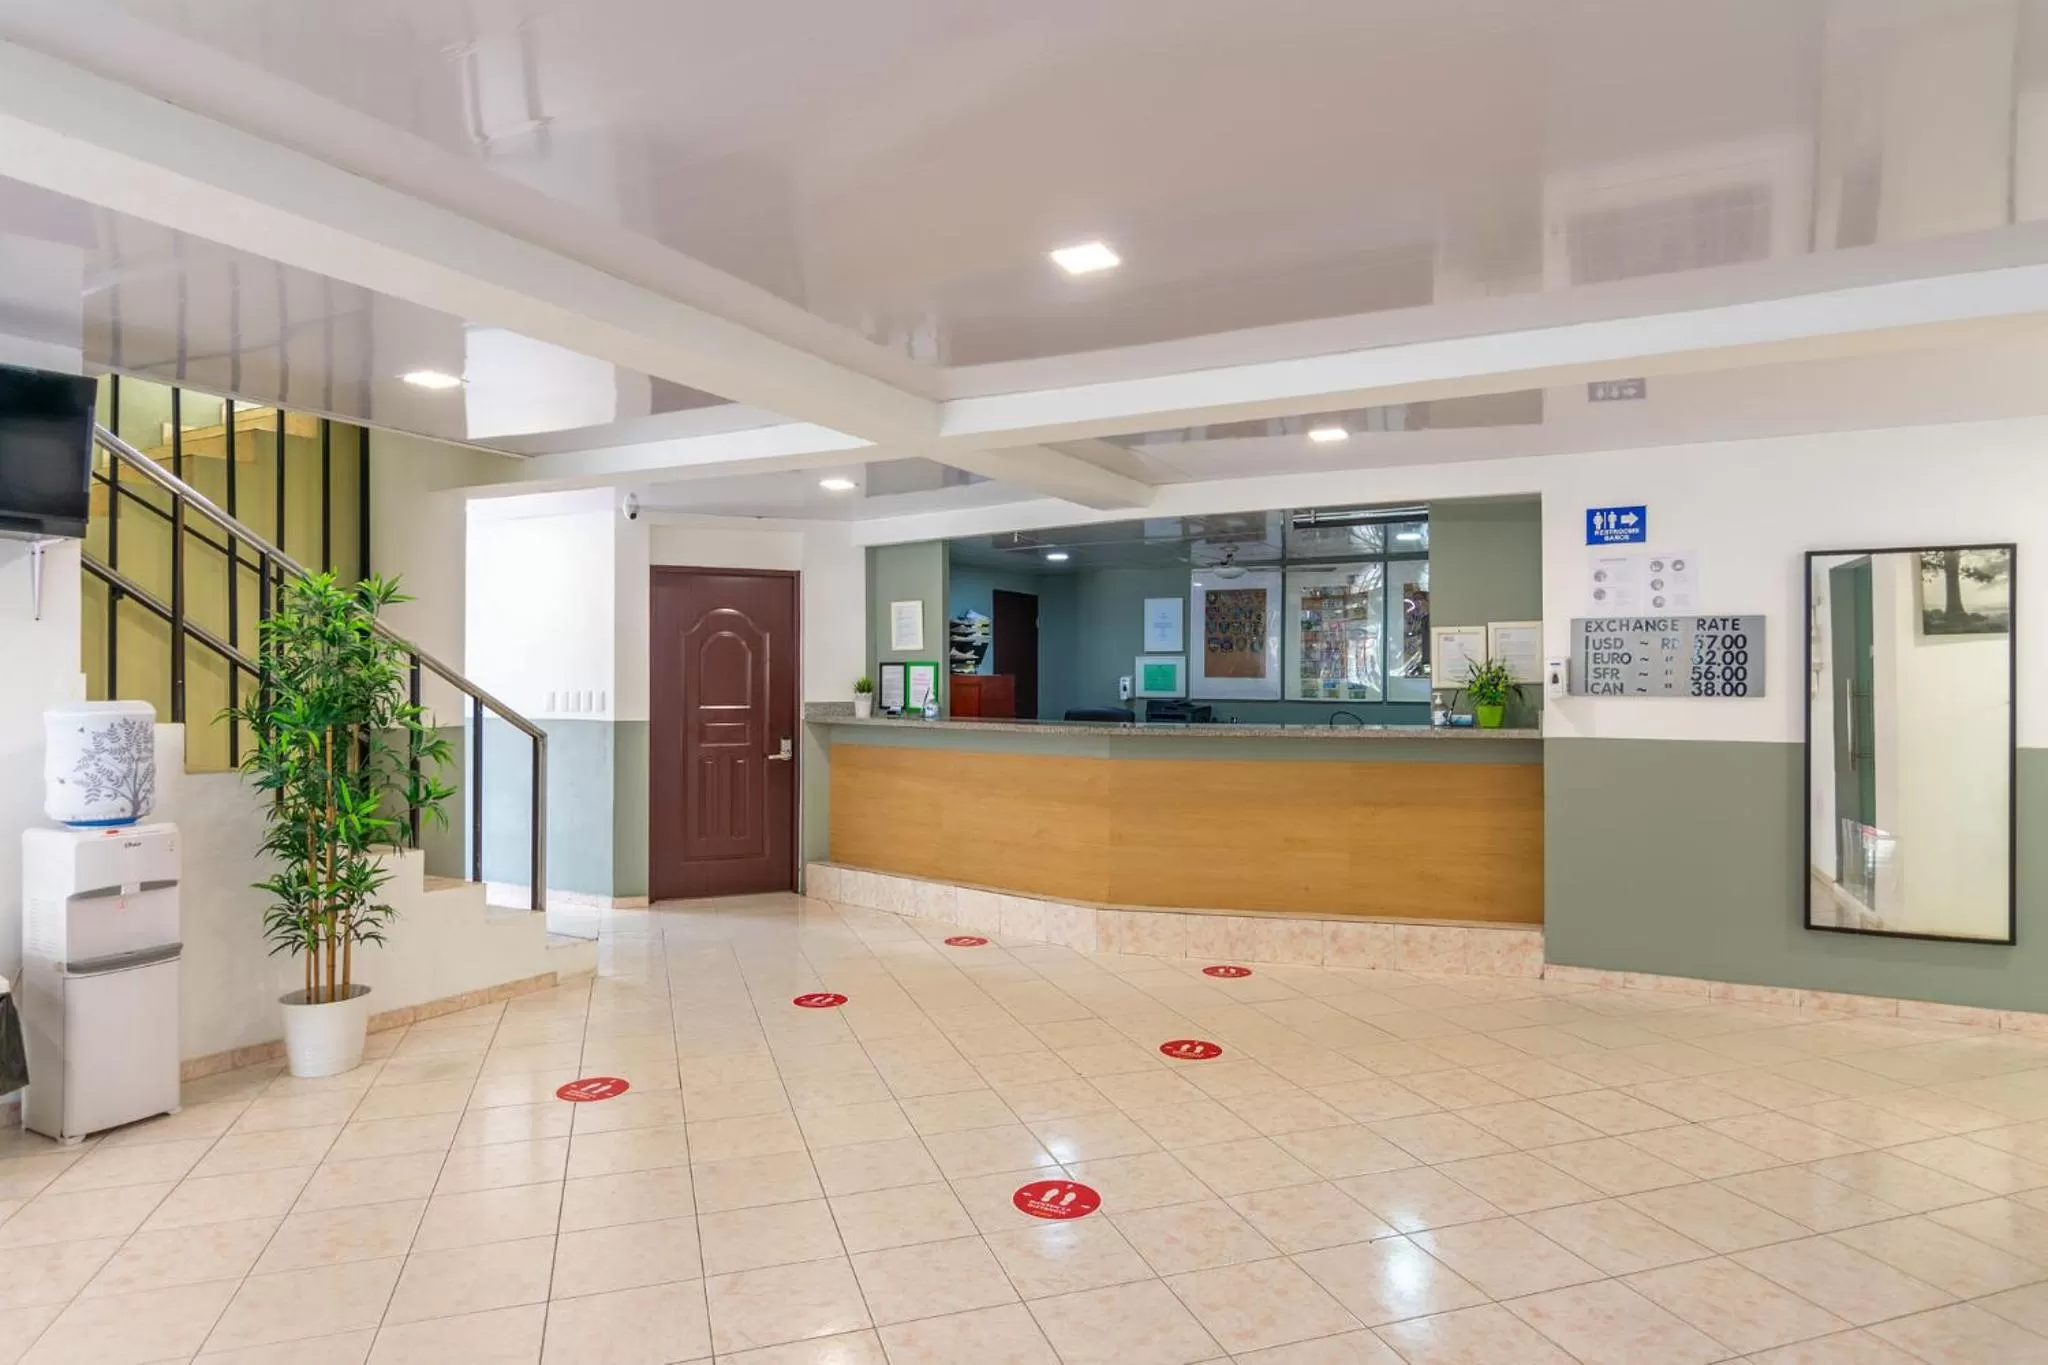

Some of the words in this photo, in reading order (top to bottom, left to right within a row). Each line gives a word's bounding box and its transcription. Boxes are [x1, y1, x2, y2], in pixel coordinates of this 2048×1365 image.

[1594, 528, 1640, 536] RESTROOMS
[1584, 619, 1680, 633] EXCHANGE
[1696, 617, 1741, 632] RATE
[1592, 637, 1624, 650] USD
[1593, 652, 1632, 665] EURO
[1593, 667, 1620, 680] SFR
[1691, 666, 1747, 682] 56.00
[1590, 682, 1624, 695] CAN
[1691, 681, 1747, 697] 38.00
